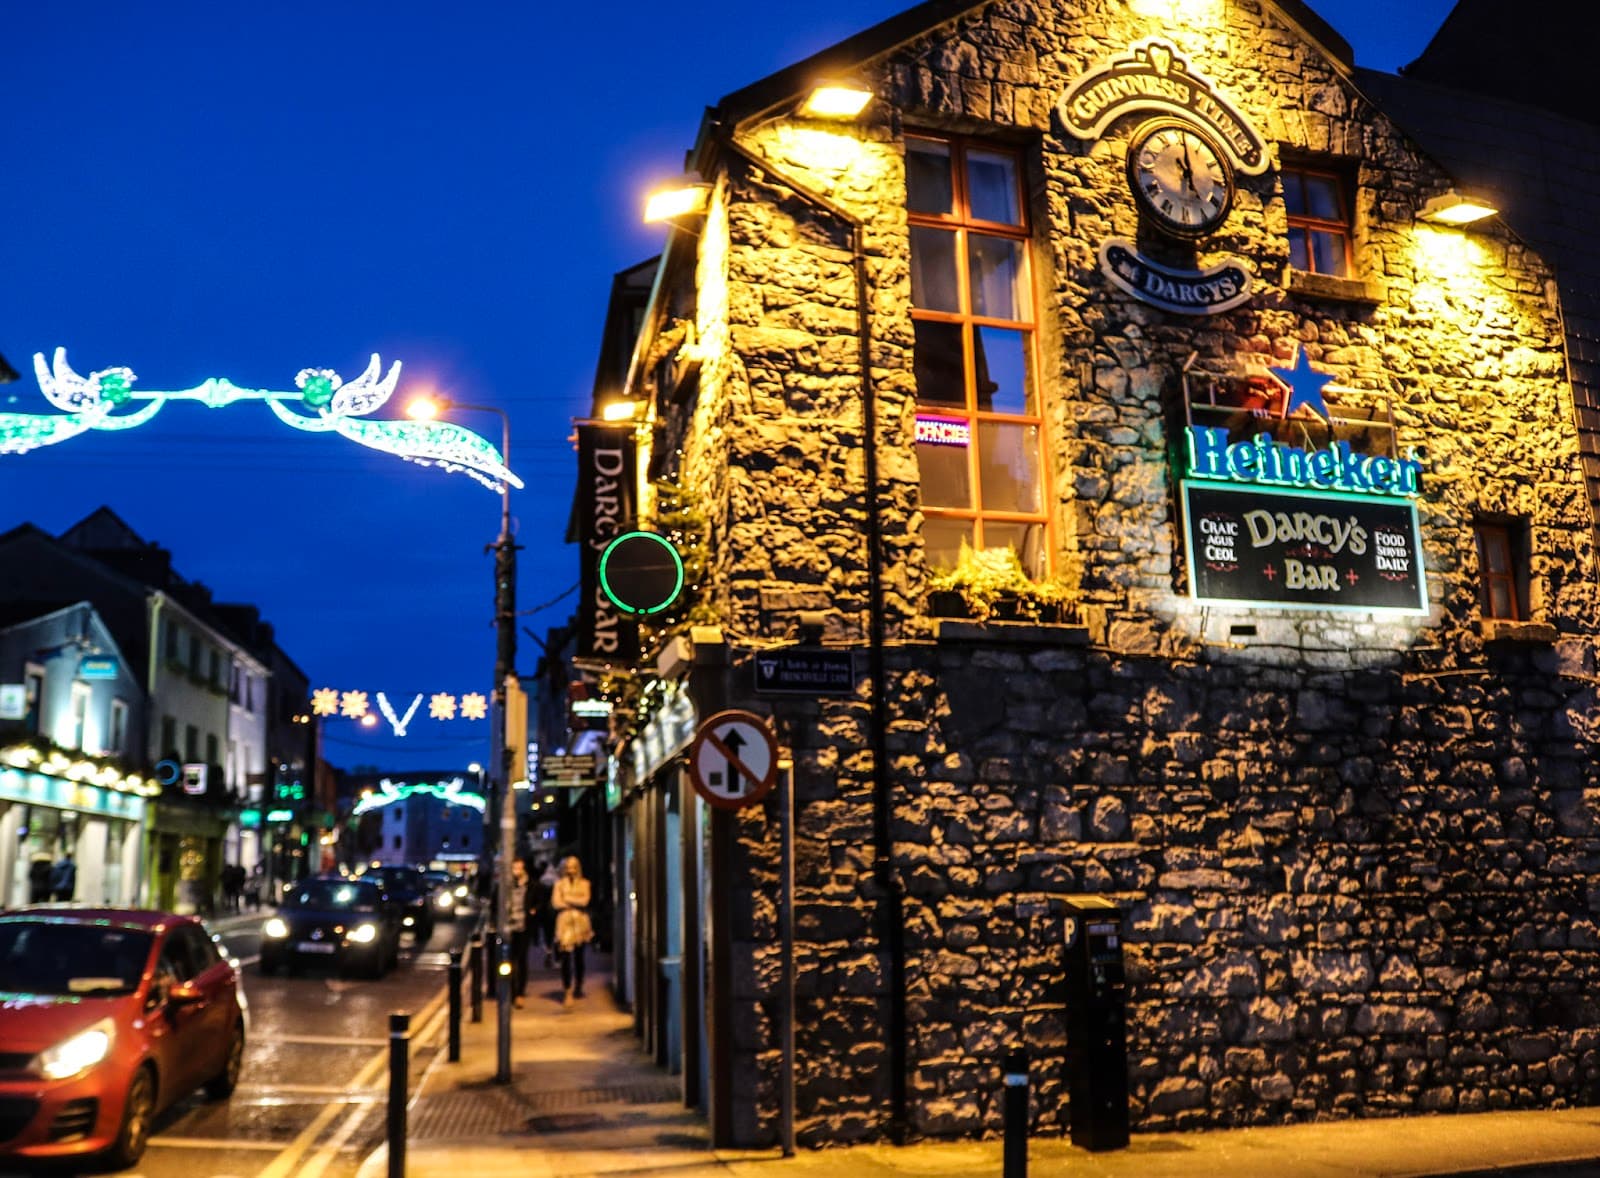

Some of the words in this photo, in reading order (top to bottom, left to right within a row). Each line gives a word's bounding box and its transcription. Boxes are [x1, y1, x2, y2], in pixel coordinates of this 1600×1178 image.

[1074, 75, 1190, 119] GUINNESS
[1195, 91, 1252, 156] TIME
[1200, 518, 1238, 536] CRAIC
[1207, 534, 1234, 547] AGUS
[1374, 531, 1406, 547] FOOD
[1205, 545, 1238, 562] CEOL
[1377, 546, 1407, 558] SERVED
[1375, 555, 1410, 571] DAILY
